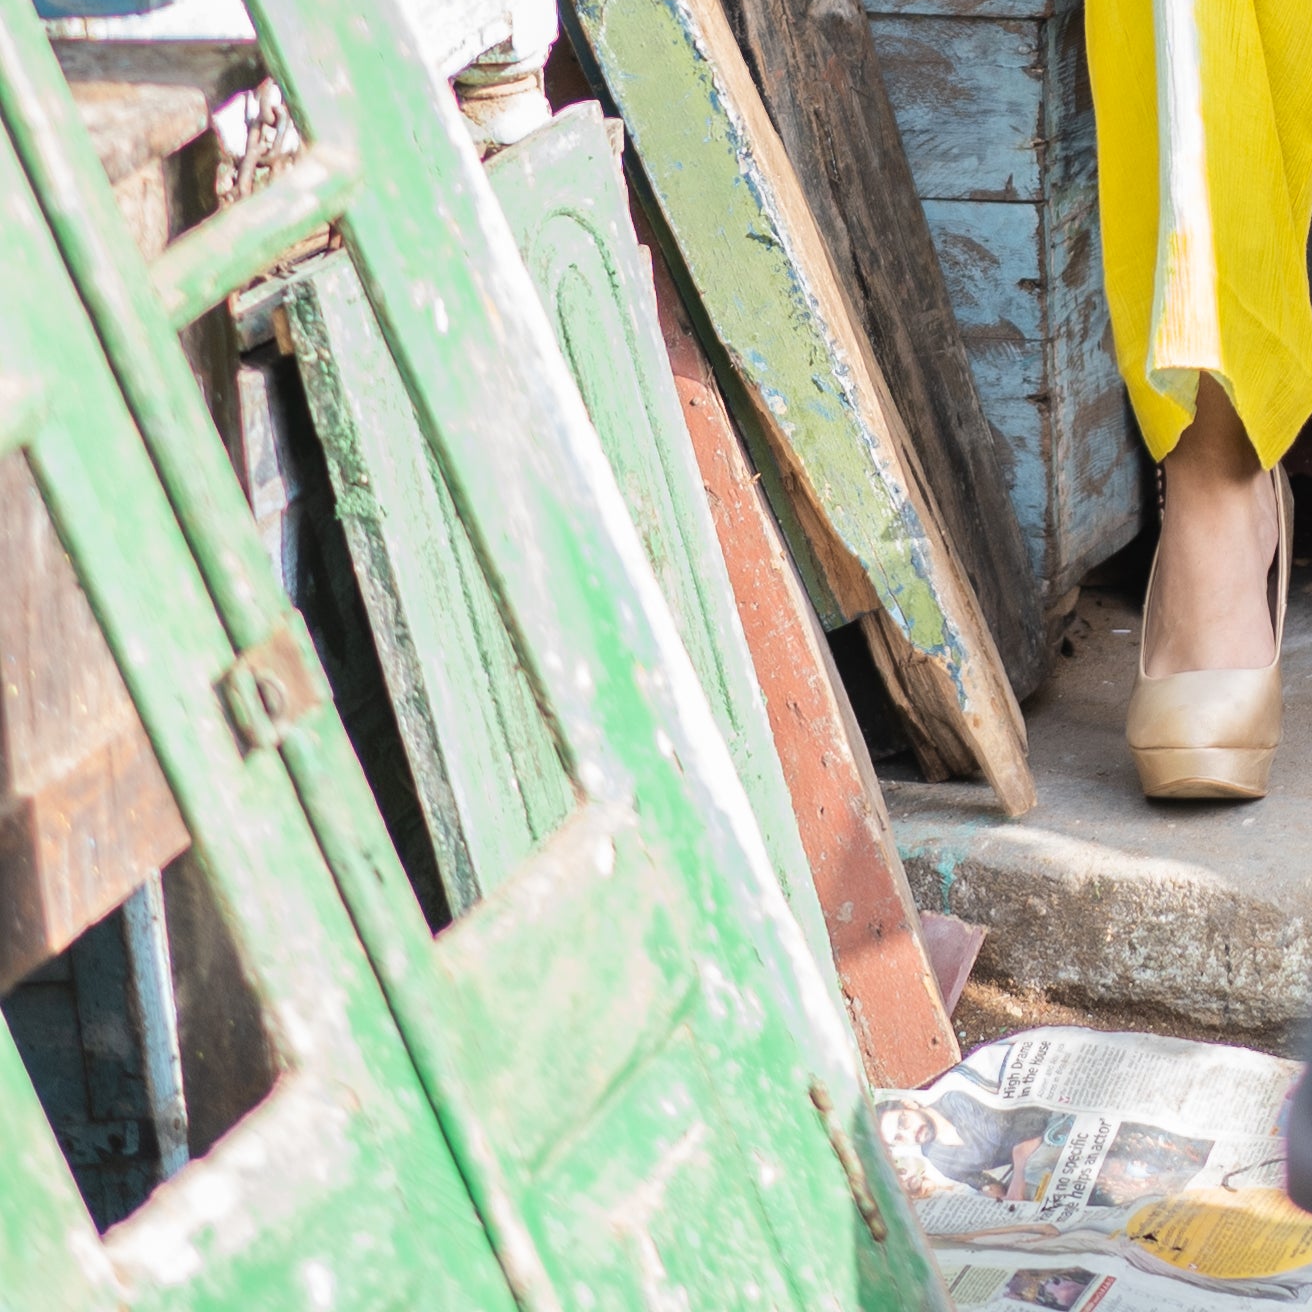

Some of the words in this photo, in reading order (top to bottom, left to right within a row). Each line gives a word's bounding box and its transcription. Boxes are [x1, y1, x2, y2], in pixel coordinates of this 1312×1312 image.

[1011, 1041, 1033, 1069] Drama
[1029, 1040, 1052, 1071] House
[1003, 1070, 1021, 1099] High
[1018, 1082, 1031, 1098] in
[1022, 1065, 1036, 1087] the
[1055, 1173, 1069, 1191] no
[1062, 1132, 1090, 1176] specific
[1070, 1166, 1094, 1200] helps
[1084, 1150, 1097, 1166] an
